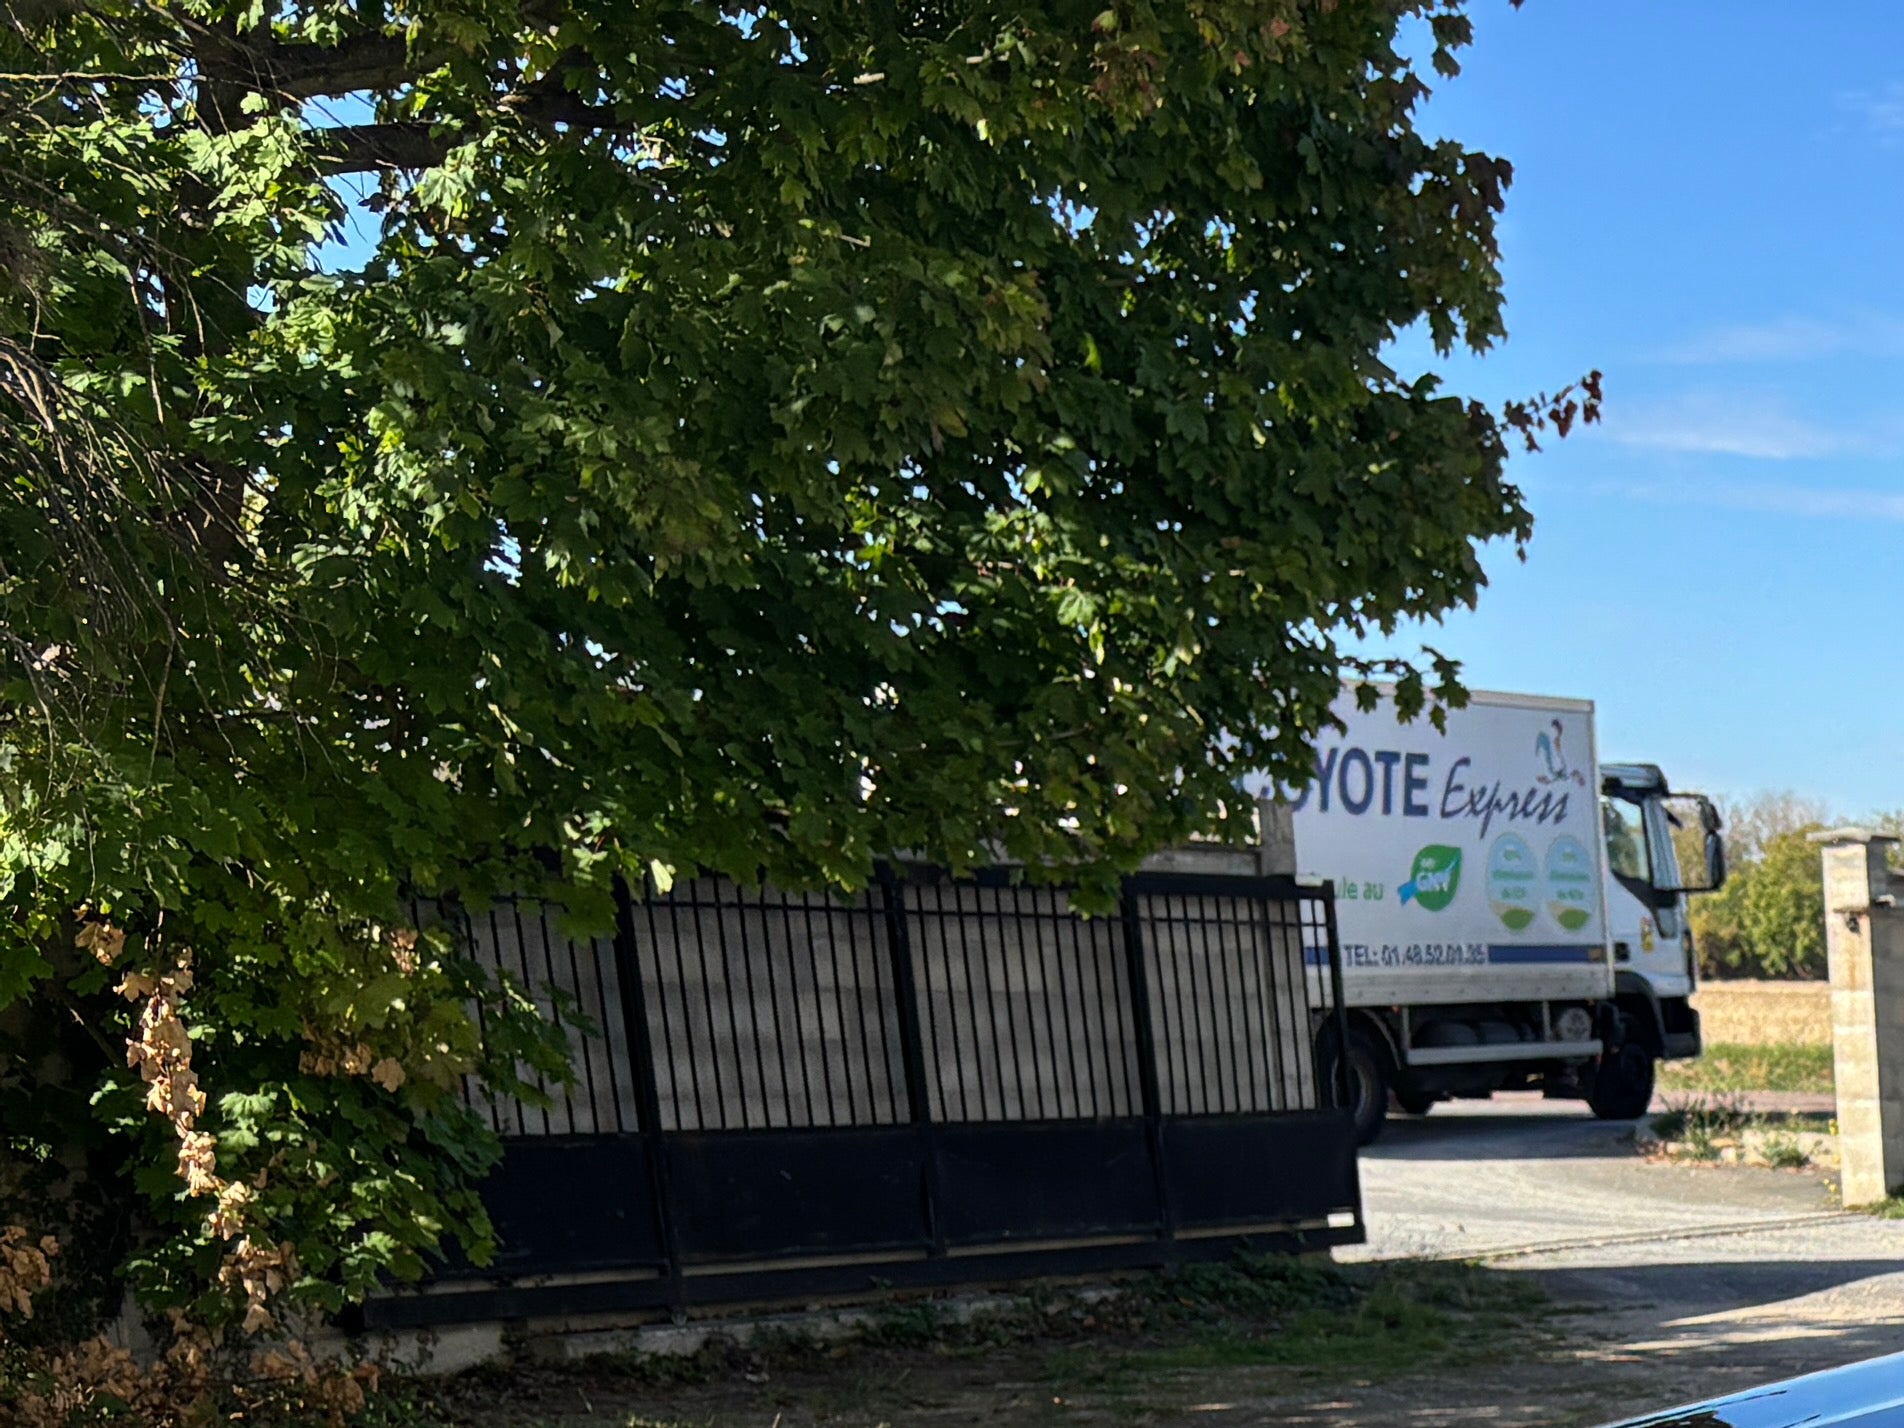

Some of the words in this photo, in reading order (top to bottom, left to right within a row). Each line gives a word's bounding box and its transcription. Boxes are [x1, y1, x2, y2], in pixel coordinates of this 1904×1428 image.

[1292, 747, 1429, 817] YOTE
[1440, 756, 1569, 839] Express
[1343, 944, 1379, 967] TEL:
